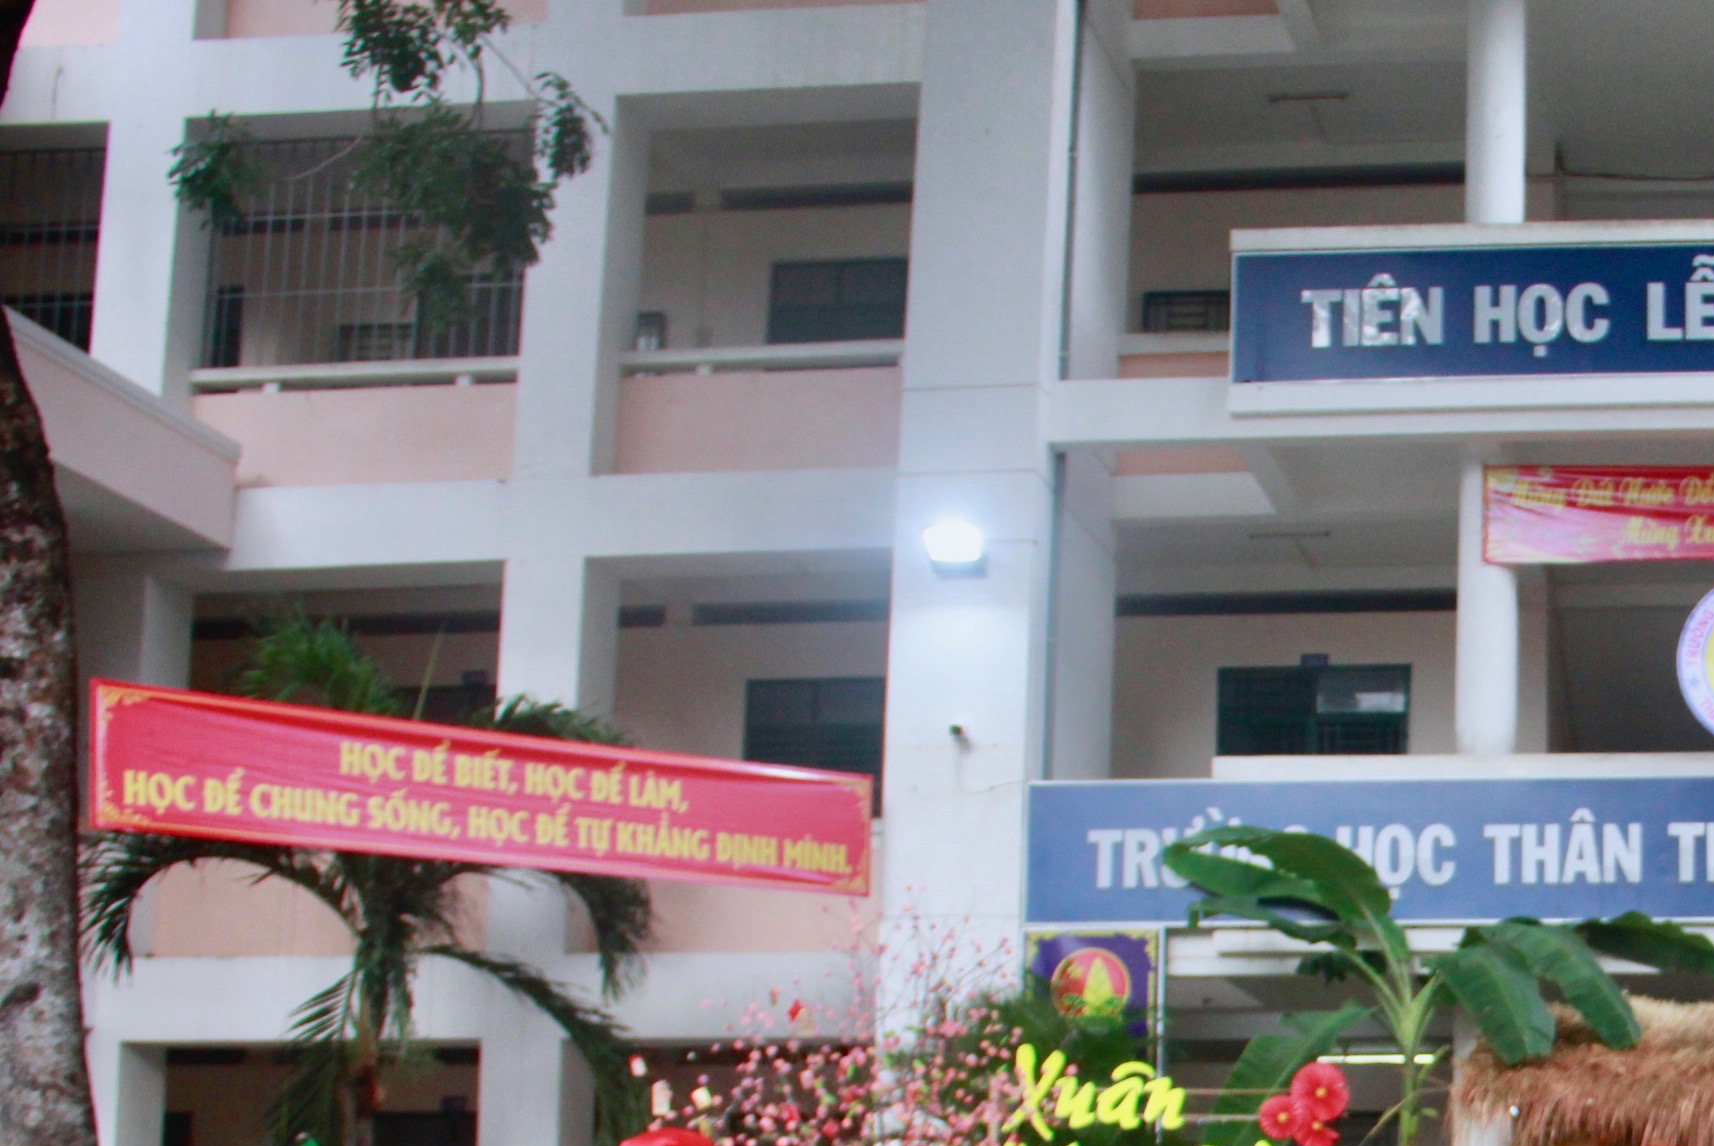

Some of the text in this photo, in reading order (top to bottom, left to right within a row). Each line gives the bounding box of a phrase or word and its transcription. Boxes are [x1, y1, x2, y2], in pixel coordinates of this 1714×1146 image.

[1302, 273, 1444, 348] TIÊN
[1473, 283, 1610, 357] HỌC
[339, 741, 406, 783] HỌC
[454, 748, 518, 795] BIẾT,
[524, 762, 585, 803] HỌC
[123, 769, 196, 815] HỌC
[250, 783, 361, 827] CHUNG
[368, 788, 461, 840] SỐNG,
[467, 805, 529, 847] HỌC
[716, 831, 778, 870] ĐỊNH
[1484, 807, 1643, 887] THÂN
[1000, 1043, 1187, 1142] Xuân
